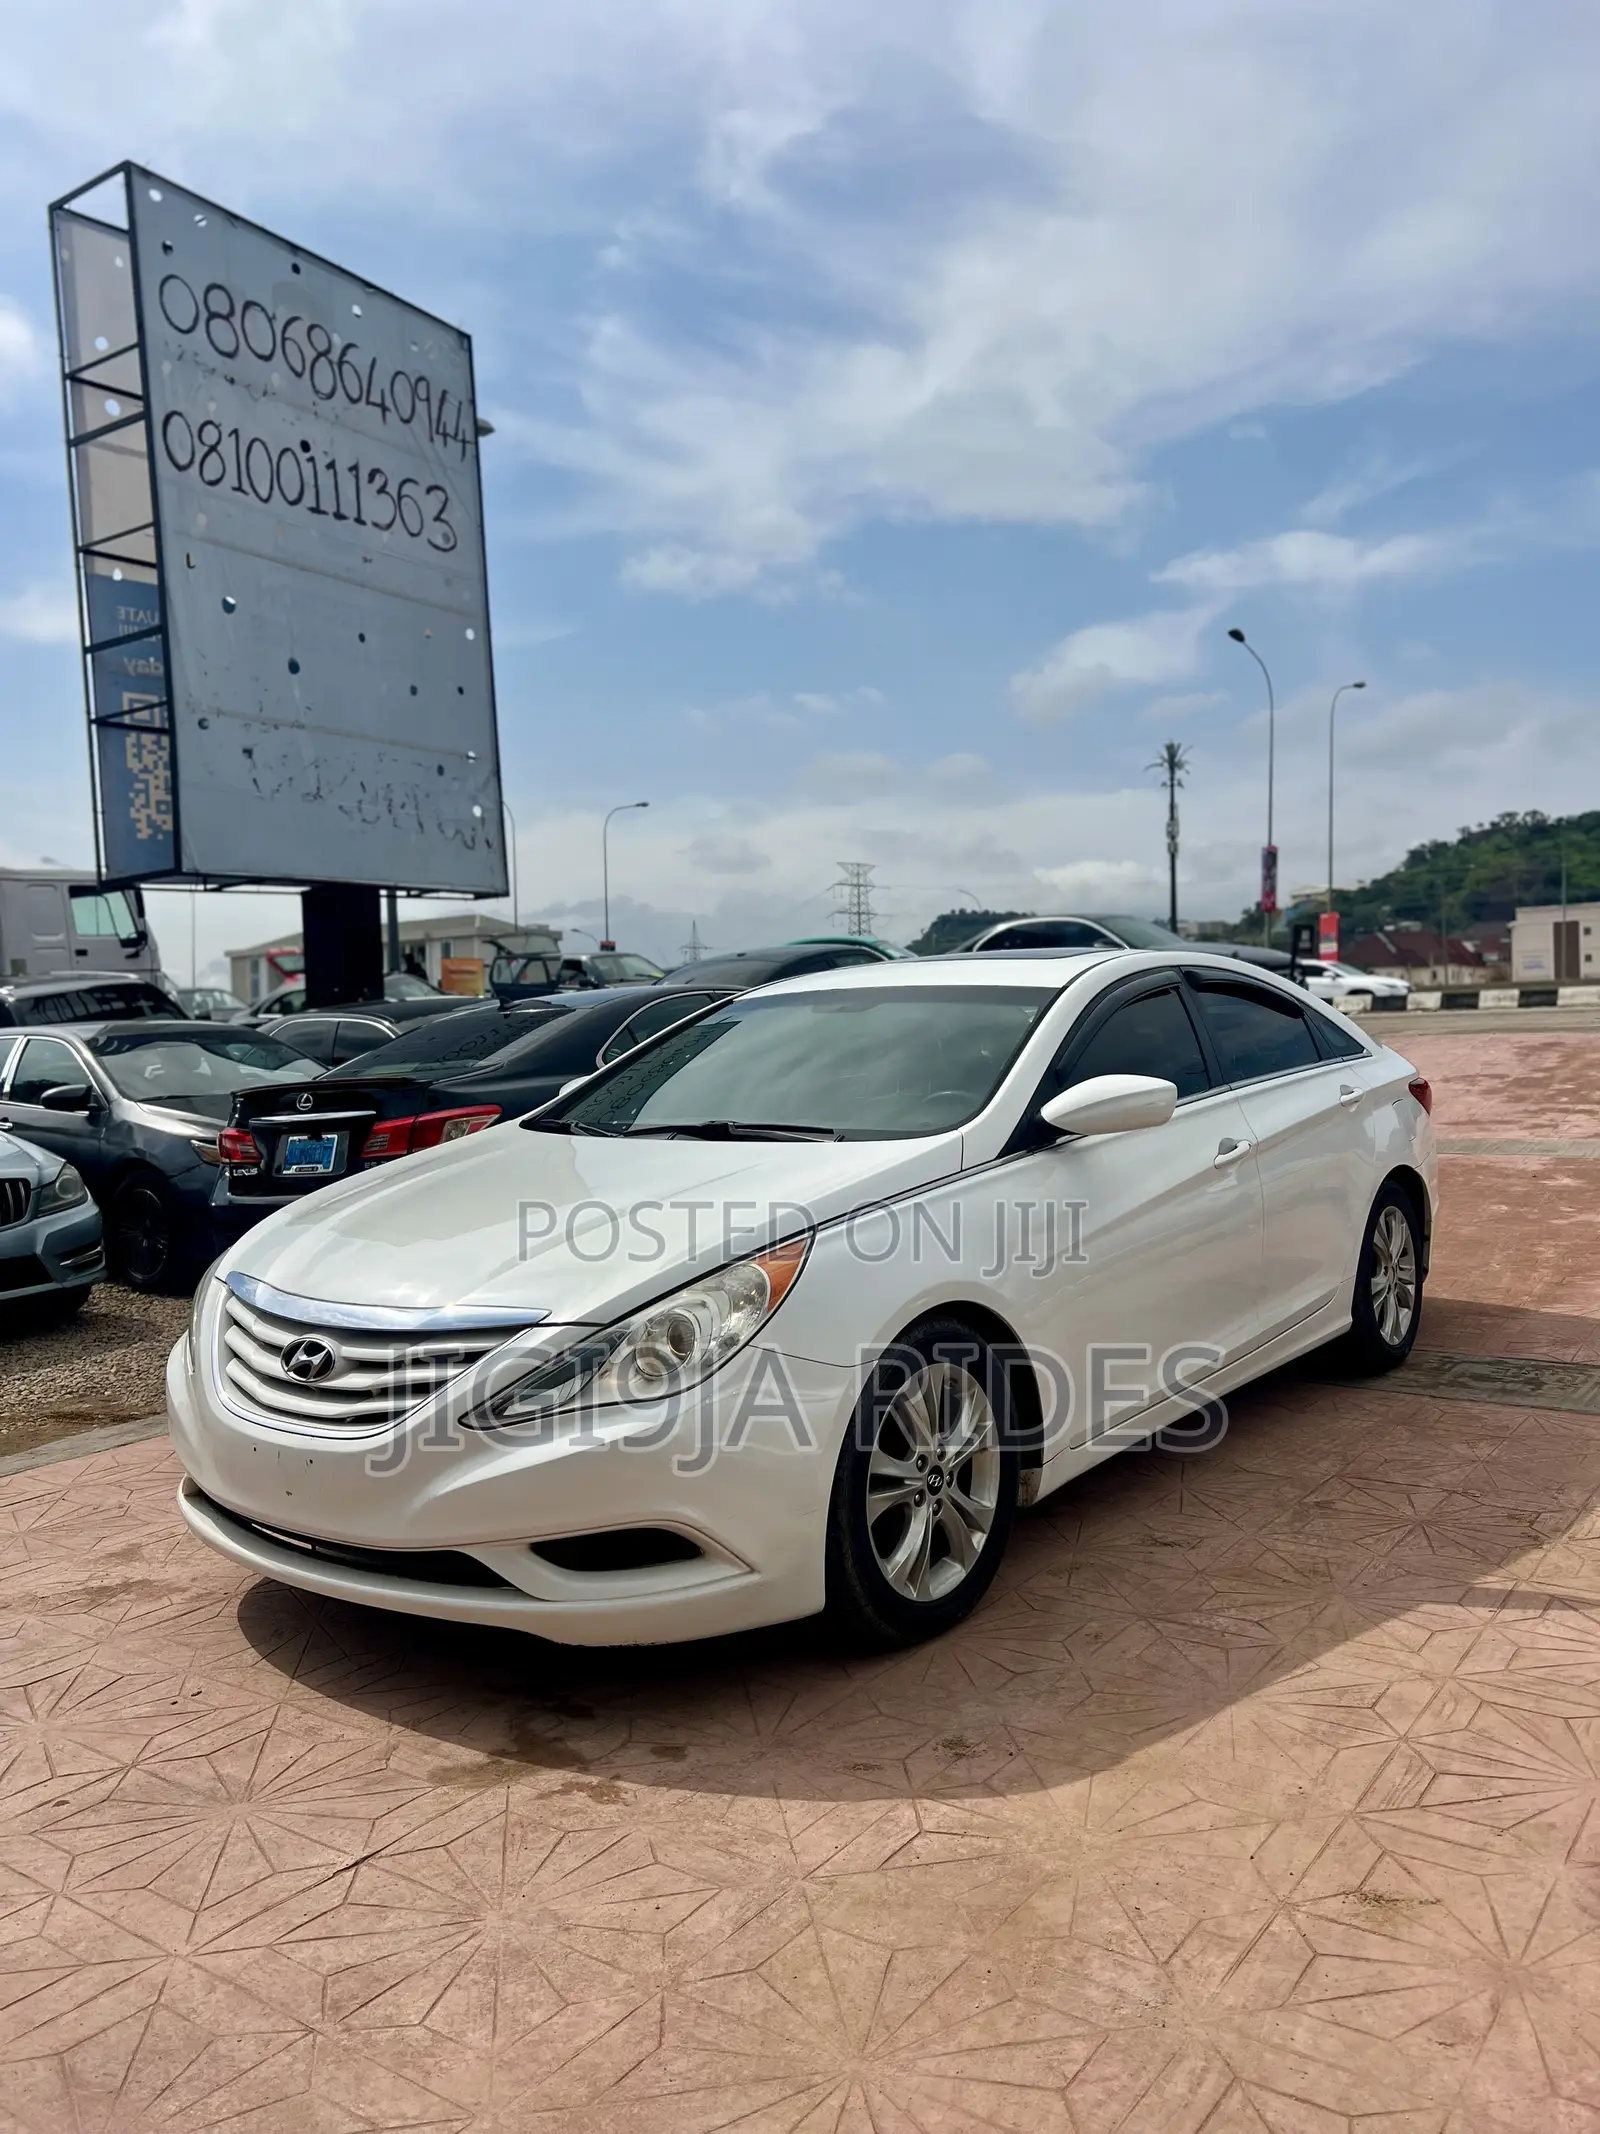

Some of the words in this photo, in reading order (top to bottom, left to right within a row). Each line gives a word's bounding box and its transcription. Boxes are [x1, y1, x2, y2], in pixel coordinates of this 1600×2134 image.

[158, 274, 475, 462] 08068640944
[162, 411, 457, 552] 08100111363
[233, 1167, 258, 1176] LEXUS
